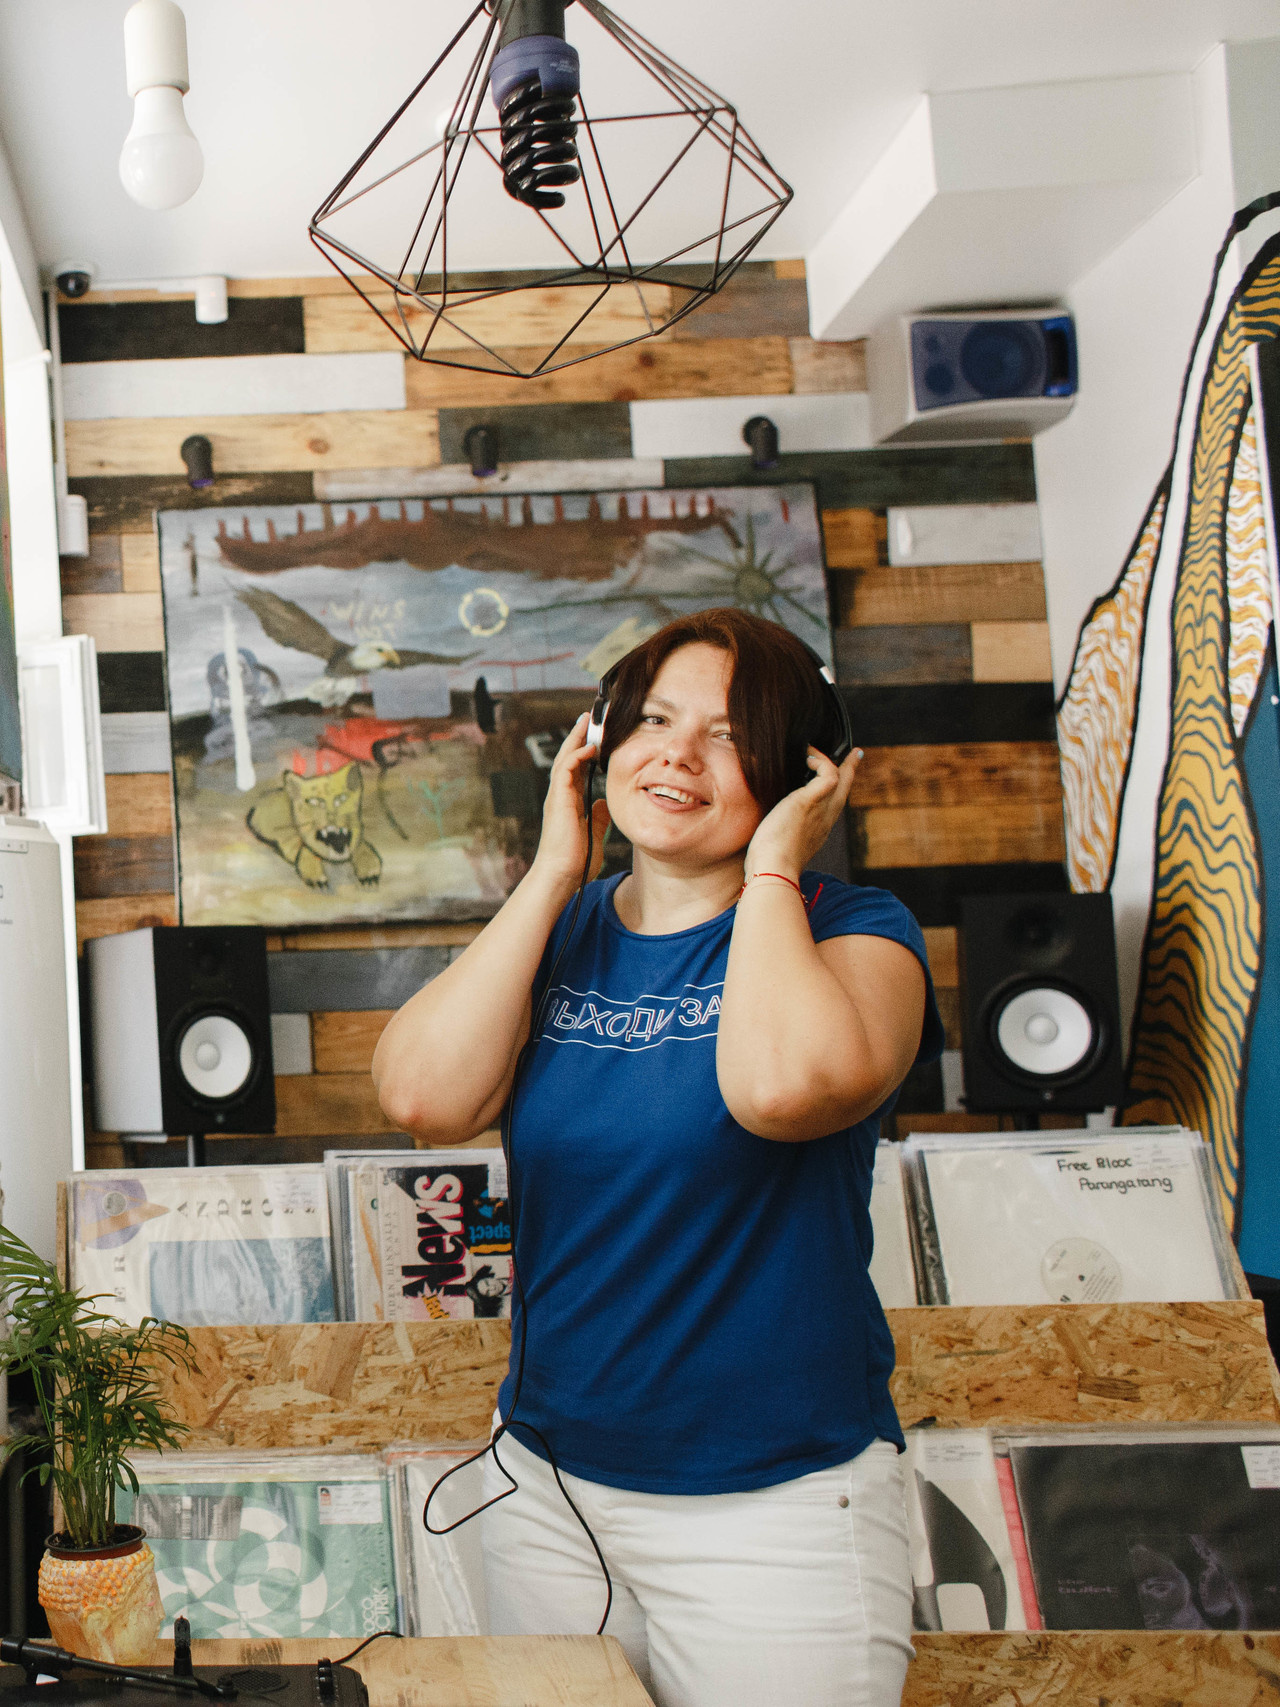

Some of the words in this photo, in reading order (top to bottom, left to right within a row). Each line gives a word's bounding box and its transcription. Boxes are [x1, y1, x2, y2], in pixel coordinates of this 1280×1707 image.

[1057, 1159, 1091, 1172] Free
[401, 1173, 466, 1298] News
[374, 1587, 388, 1630] CTRIK
